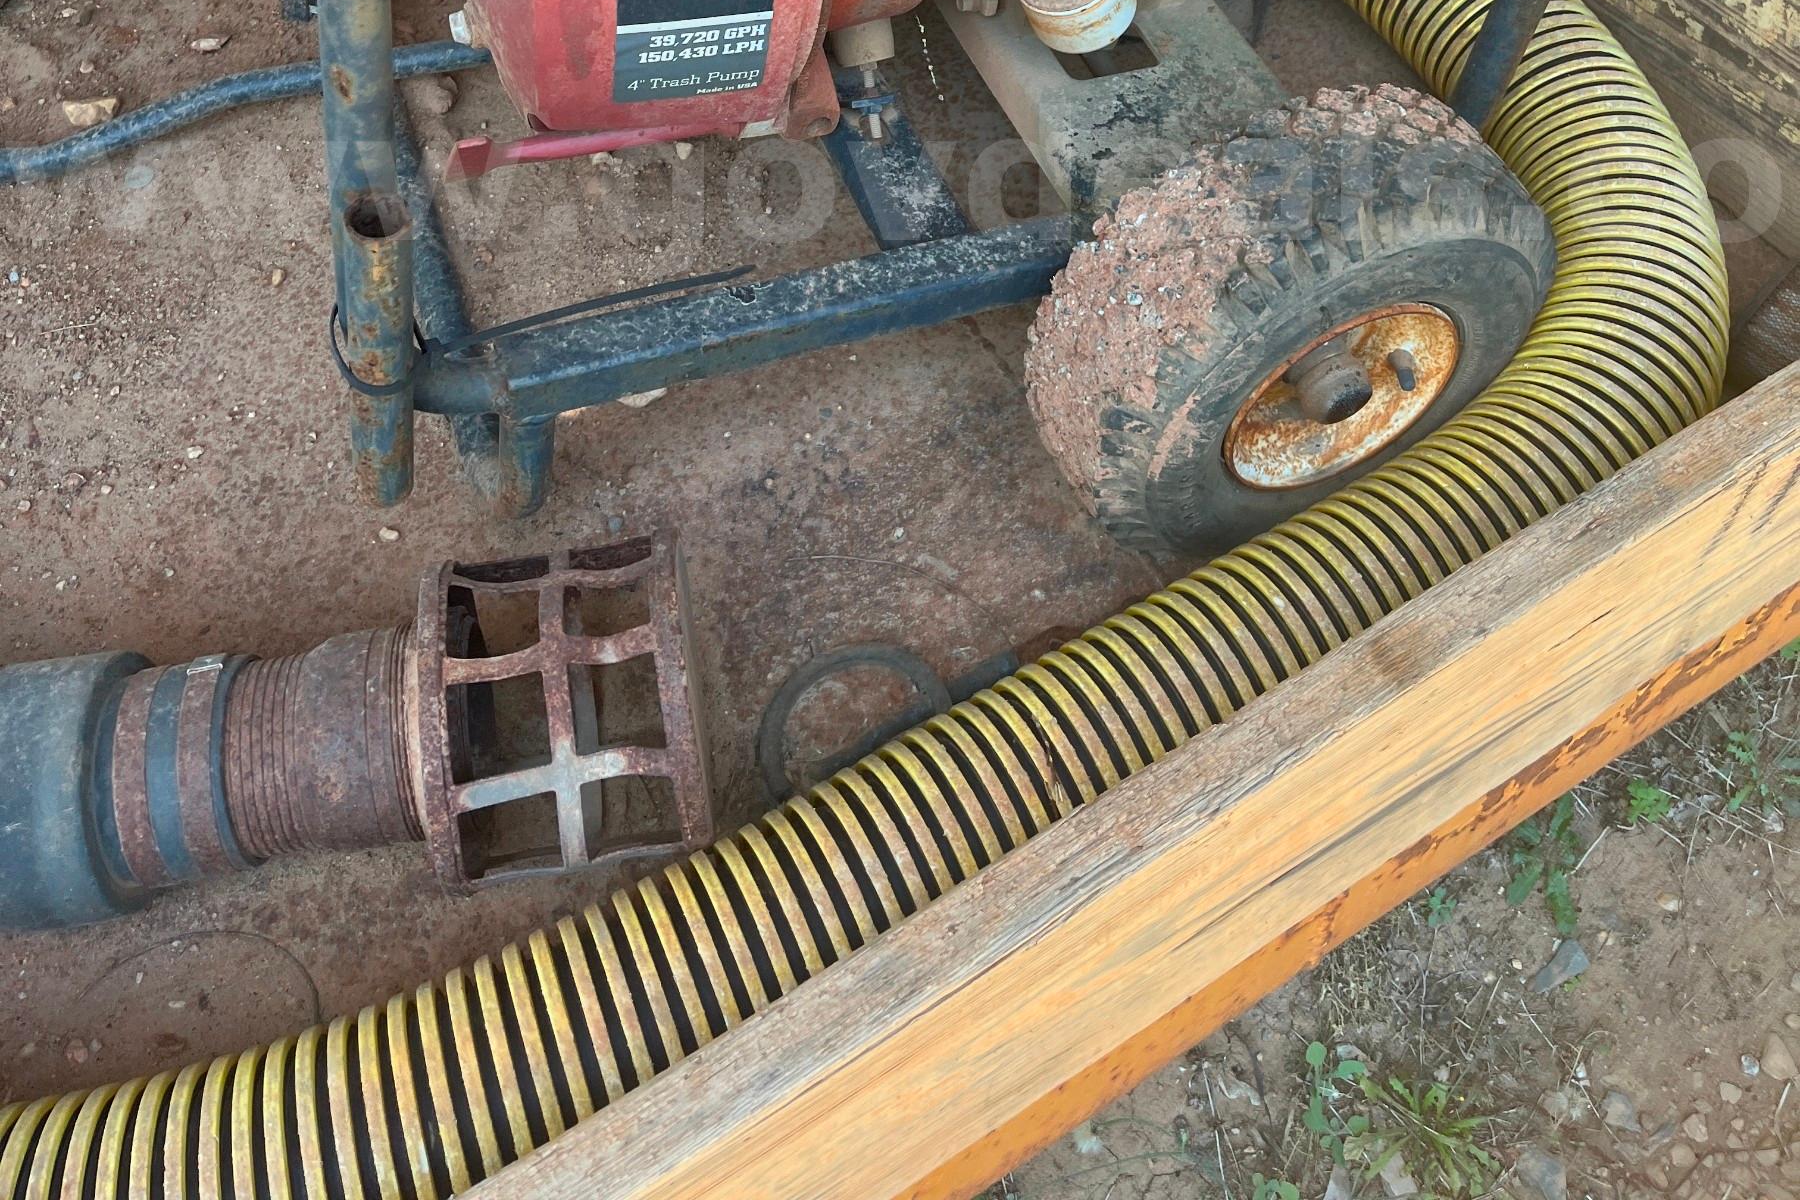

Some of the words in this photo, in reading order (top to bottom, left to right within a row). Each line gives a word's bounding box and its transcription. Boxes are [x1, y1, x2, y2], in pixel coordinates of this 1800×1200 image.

[649, 30, 720, 48] 39,720
[724, 24, 767, 40] GPH
[639, 45, 719, 64] 150,430
[722, 40, 765, 55] LPH
[650, 75, 700, 89] Trash
[706, 70, 760, 83] Pump
[696, 86, 722, 94] Made
